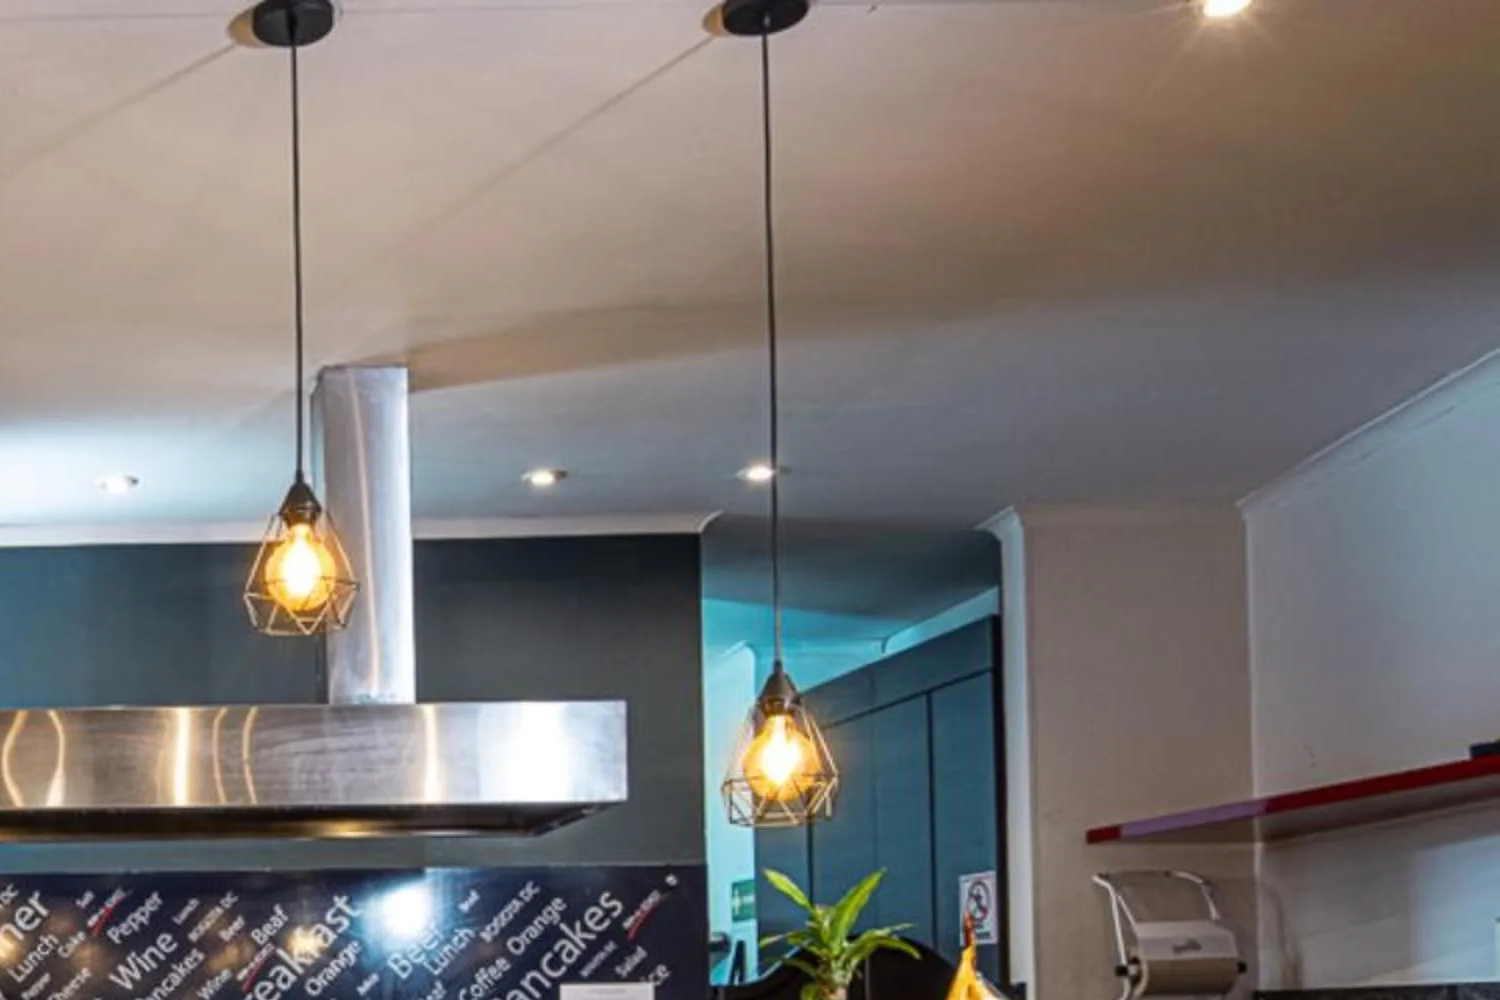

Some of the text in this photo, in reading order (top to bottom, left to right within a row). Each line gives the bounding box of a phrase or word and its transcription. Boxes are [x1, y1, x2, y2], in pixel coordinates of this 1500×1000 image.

[106, 890, 163, 944] Pepper
[251, 903, 289, 945] Beaf
[506, 897, 567, 956] Orange
[7, 934, 59, 983] Lunch
[108, 932, 179, 990] Wine
[304, 940, 361, 996] Orange
[423, 928, 476, 976] Lunch
[196, 968, 233, 1000] Wine
